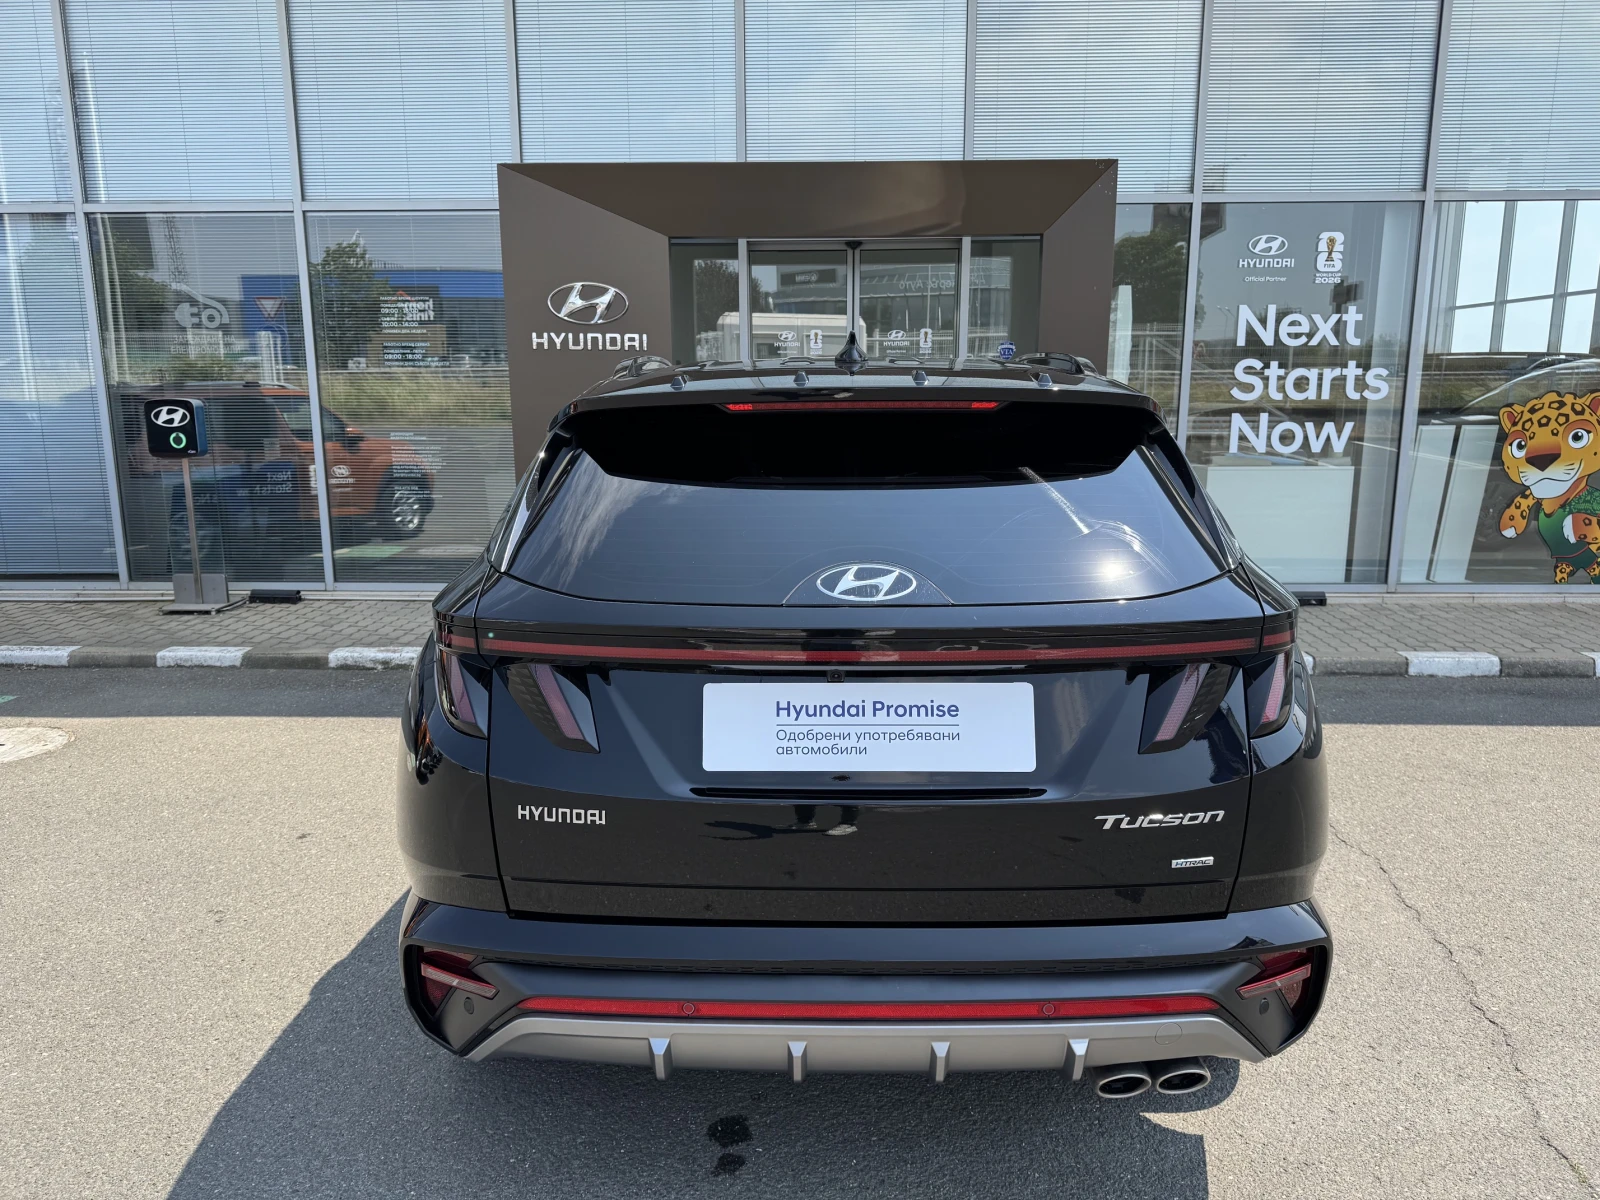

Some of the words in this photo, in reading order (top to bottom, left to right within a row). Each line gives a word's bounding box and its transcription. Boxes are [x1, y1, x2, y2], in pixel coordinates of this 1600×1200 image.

[1239, 258, 1295, 268] HYUNDAI
[1236, 304, 1363, 346] Next
[531, 332, 648, 351] HYUNDAI
[1229, 358, 1390, 401] Starts
[1228, 412, 1355, 454] Now
[775, 699, 866, 721] Hyundai
[872, 699, 960, 718] Promise
[775, 728, 851, 743] Одобрени
[854, 728, 960, 743] употребявани
[775, 742, 867, 755] автомобили
[517, 804, 606, 825] HYUNDAI
[1174, 859, 1212, 867] HTRAC
